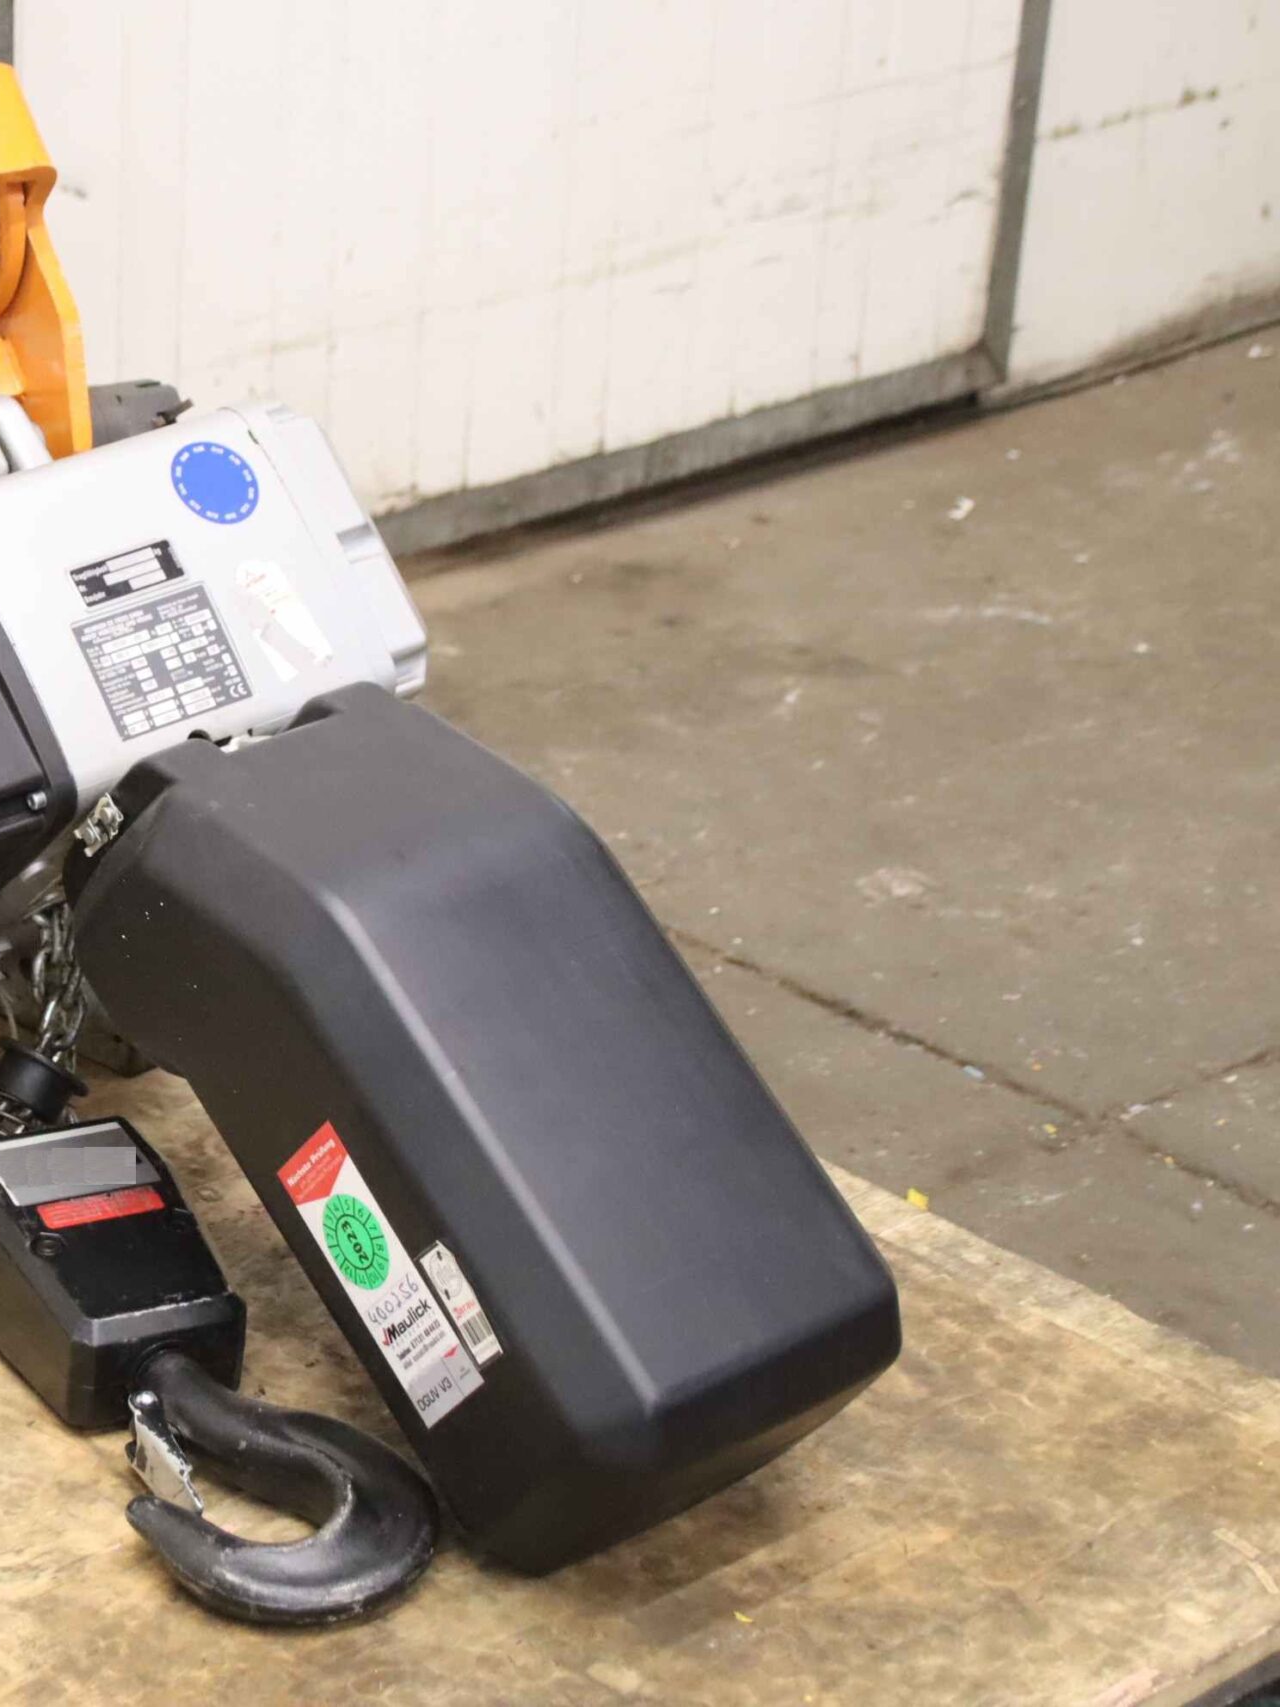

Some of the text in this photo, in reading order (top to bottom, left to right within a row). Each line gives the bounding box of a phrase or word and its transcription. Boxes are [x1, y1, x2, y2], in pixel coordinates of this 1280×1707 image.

[230, 682, 248, 698] CE
[341, 1220, 369, 1264] 2023
[387, 1298, 432, 1344] Maulick
[417, 1376, 452, 1411] DGUV V3
